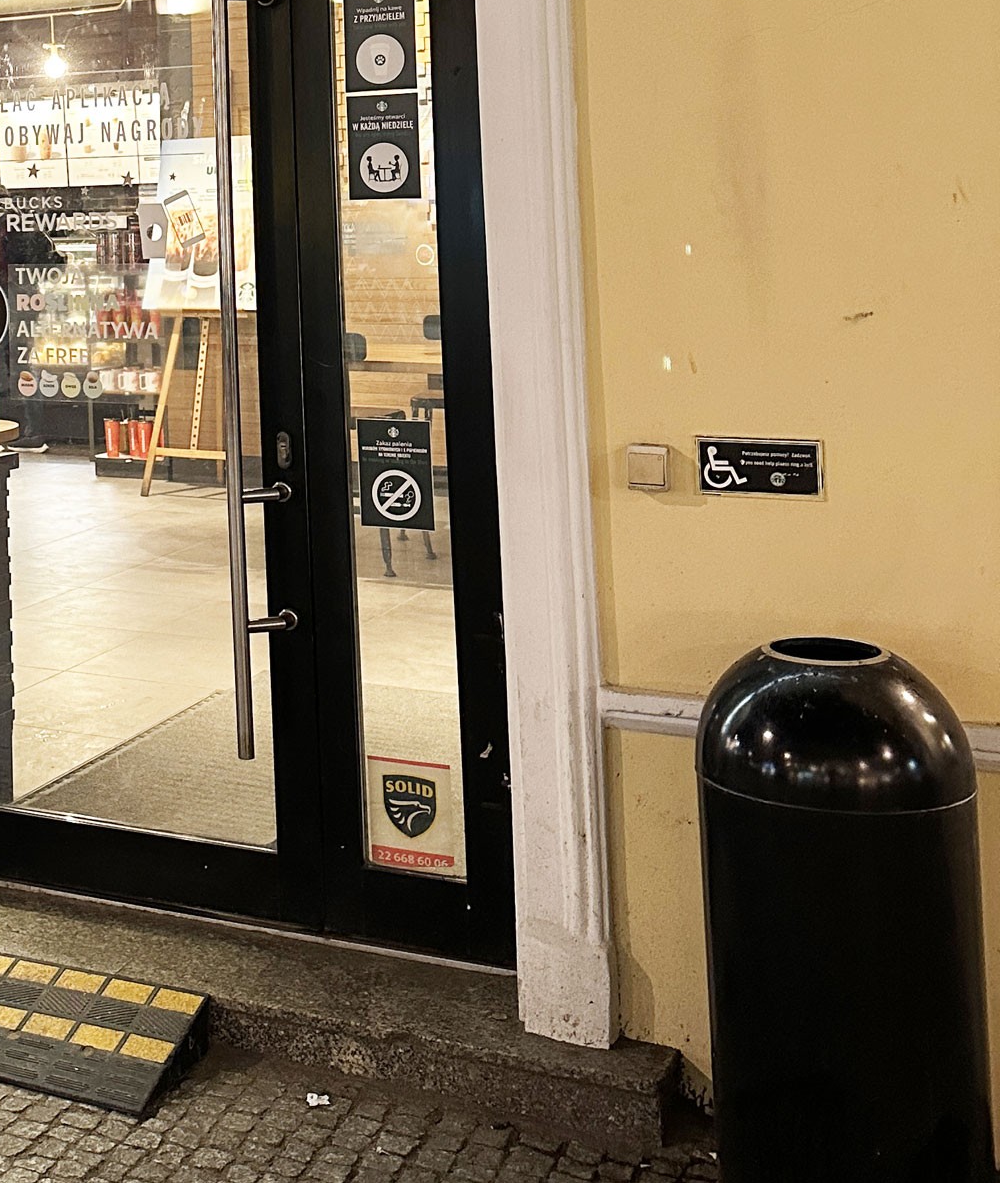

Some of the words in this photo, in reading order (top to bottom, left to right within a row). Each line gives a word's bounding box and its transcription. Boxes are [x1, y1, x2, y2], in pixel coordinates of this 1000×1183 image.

[353, 15, 359, 24] Z
[352, 122, 359, 131] W
[360, 121, 381, 131] KAŻDĄ
[381, 120, 414, 130] NIEDZIELĘ
[6, 211, 118, 233] REWARDS
[15, 267, 85, 285] TWOJA
[16, 320, 159, 340] ALTERNATYWA
[17, 346, 41, 364] ZA
[385, 780, 434, 798] SOLID
[377, 849, 392, 861] 22
[393, 851, 415, 864] 668
[417, 856, 431, 867] 60
